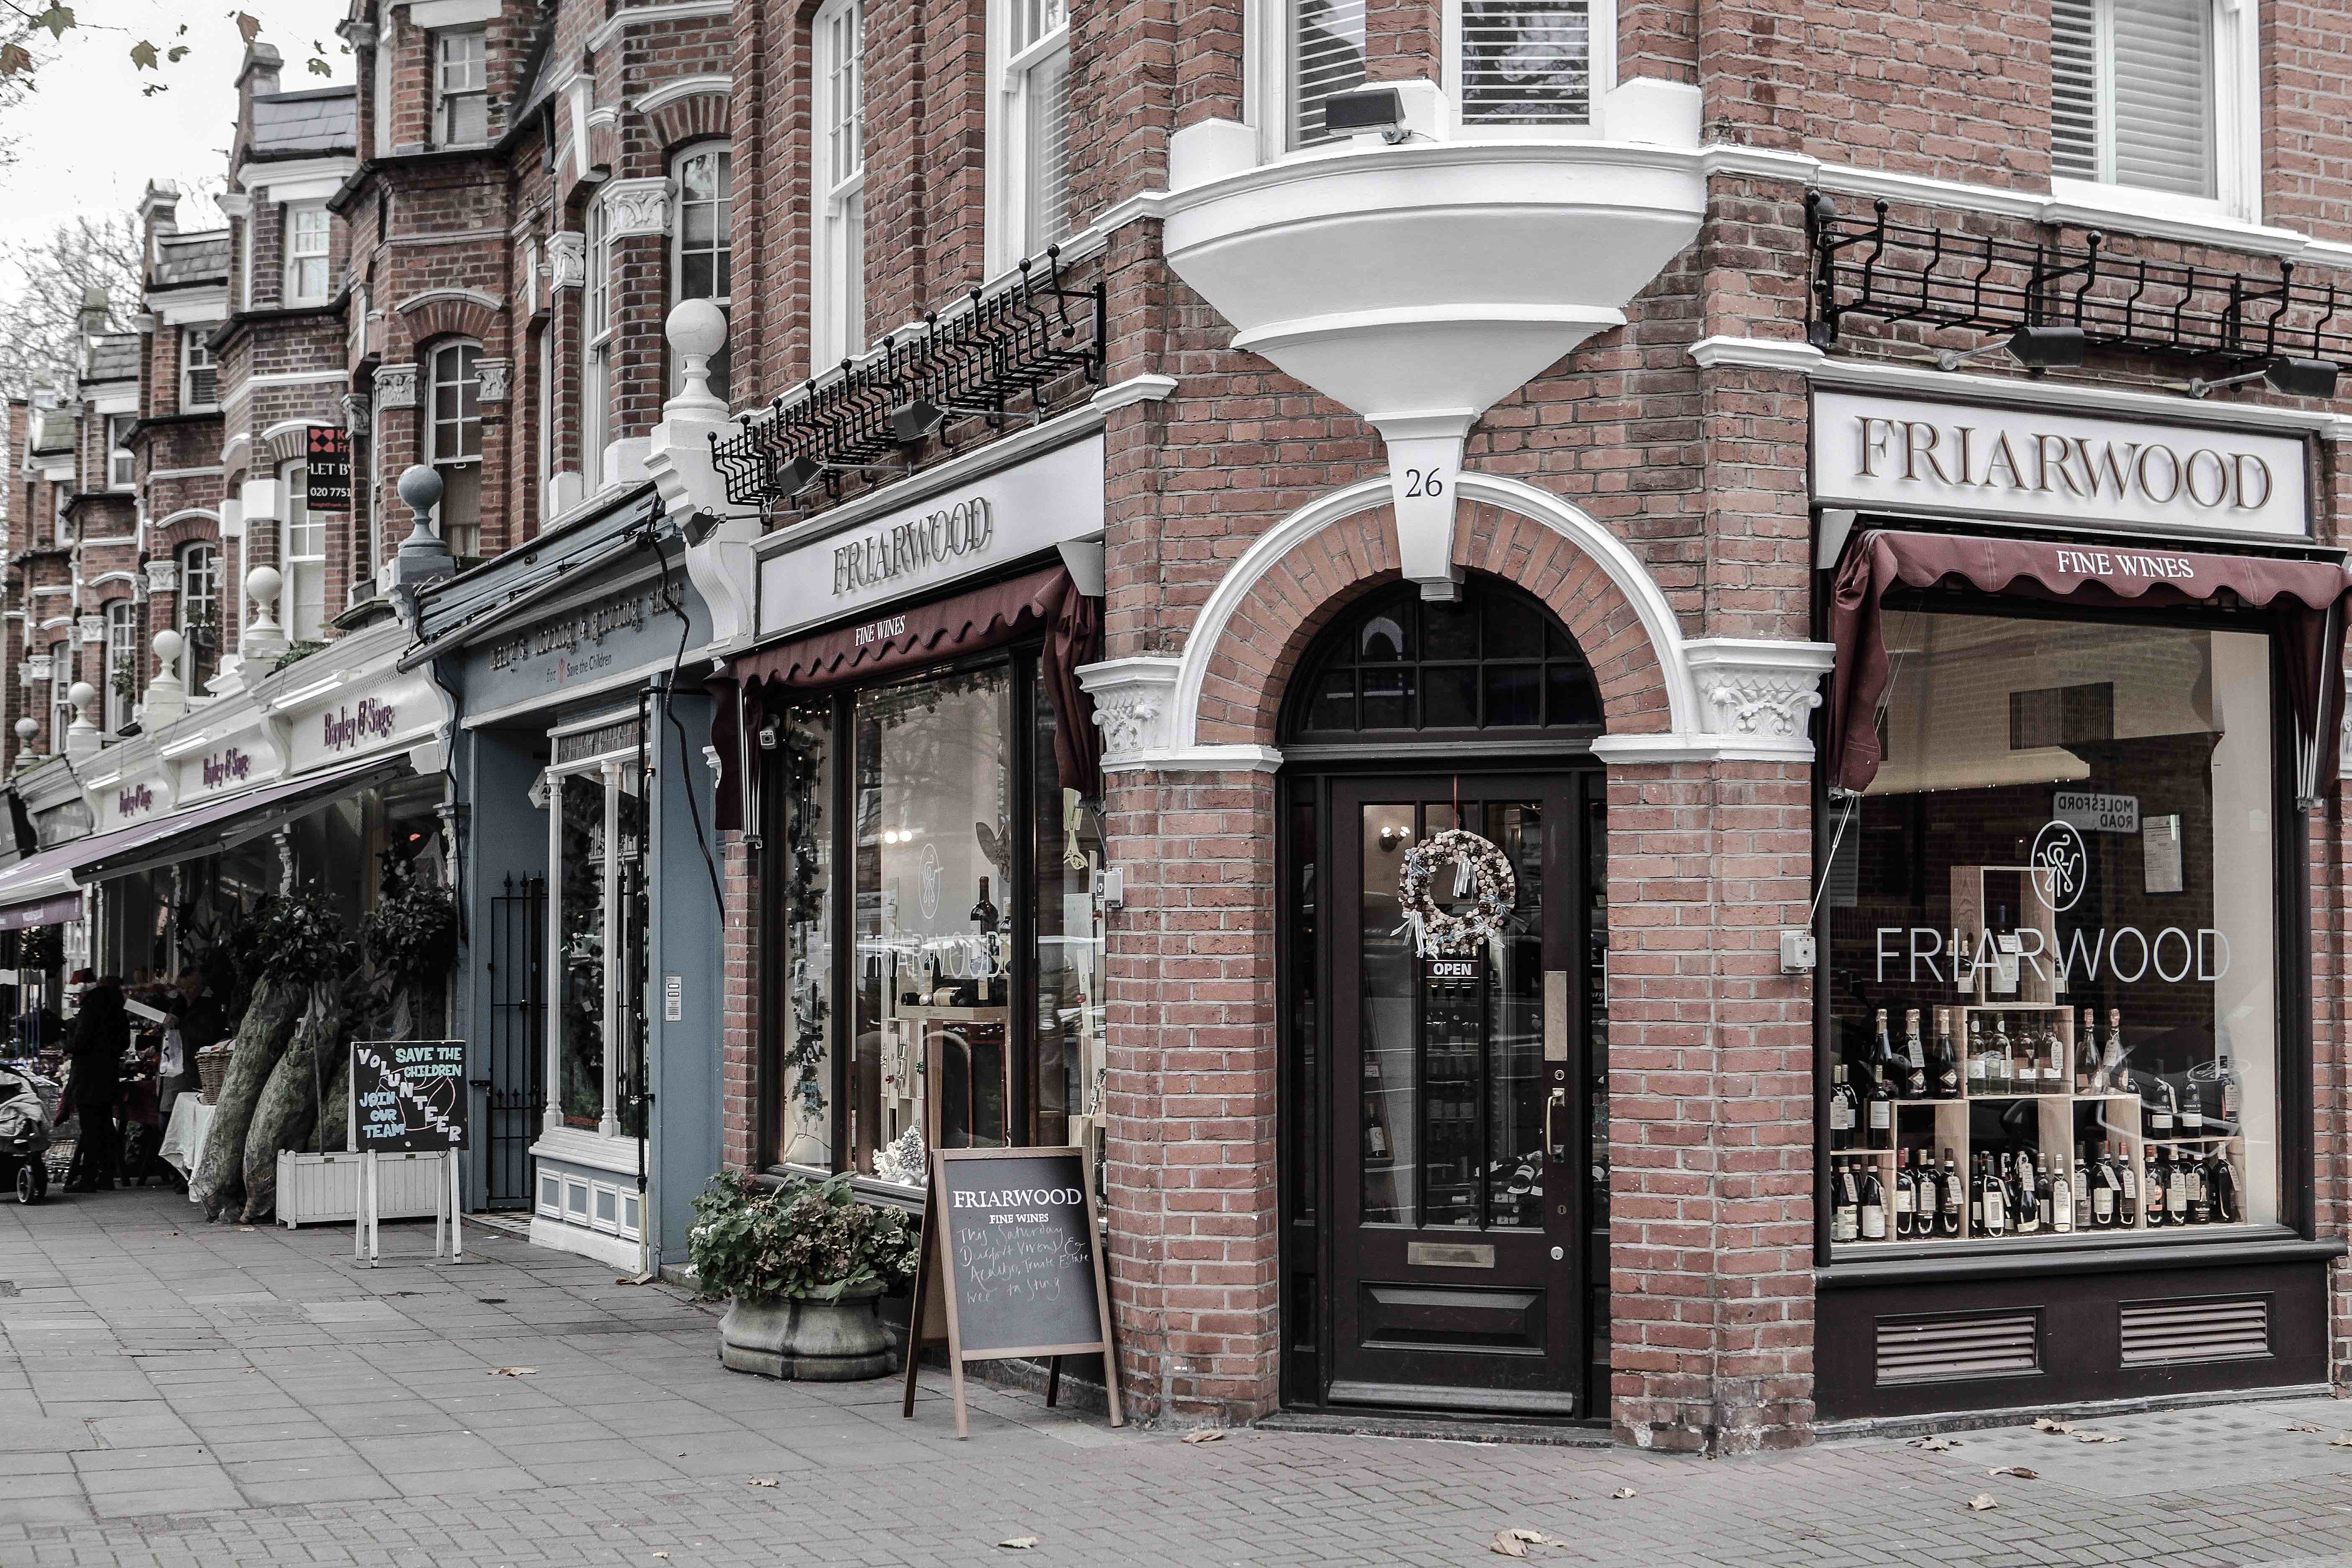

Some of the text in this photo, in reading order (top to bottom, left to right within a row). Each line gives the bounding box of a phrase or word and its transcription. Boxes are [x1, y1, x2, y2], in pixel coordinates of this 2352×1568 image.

[310, 463, 349, 475] LET B
[1854, 415, 2273, 510] FRIARWOOD
[310, 487, 351, 497] 020 7751
[1405, 467, 1442, 498] 26
[831, 497, 989, 596] FRIARWOOD
[2057, 550, 2195, 578] FINE WINES
[592, 596, 638, 643] giving
[855, 615, 905, 646] FINE WINES
[567, 663, 578, 677] Save
[589, 652, 611, 670] Children
[324, 706, 355, 751] Bayley
[368, 698, 392, 738] Sage
[864, 931, 1001, 978] FRIARWOOD
[1877, 926, 2231, 983] FRIARWOOD
[1433, 963, 1472, 975] OPEN
[395, 1047, 462, 1063] SAVE THE
[404, 1064, 462, 1078] CHILDREN
[358, 1049, 462, 1142] VOLUNTEER
[359, 1091, 395, 1107] JOIN
[370, 1109, 397, 1122] OUR
[363, 1124, 405, 1138] TEAM
[953, 1188, 1082, 1208] FRIARWOOD
[989, 1213, 1049, 1224] FINE WINES
[957, 1225, 1063, 1248] This Saturday
